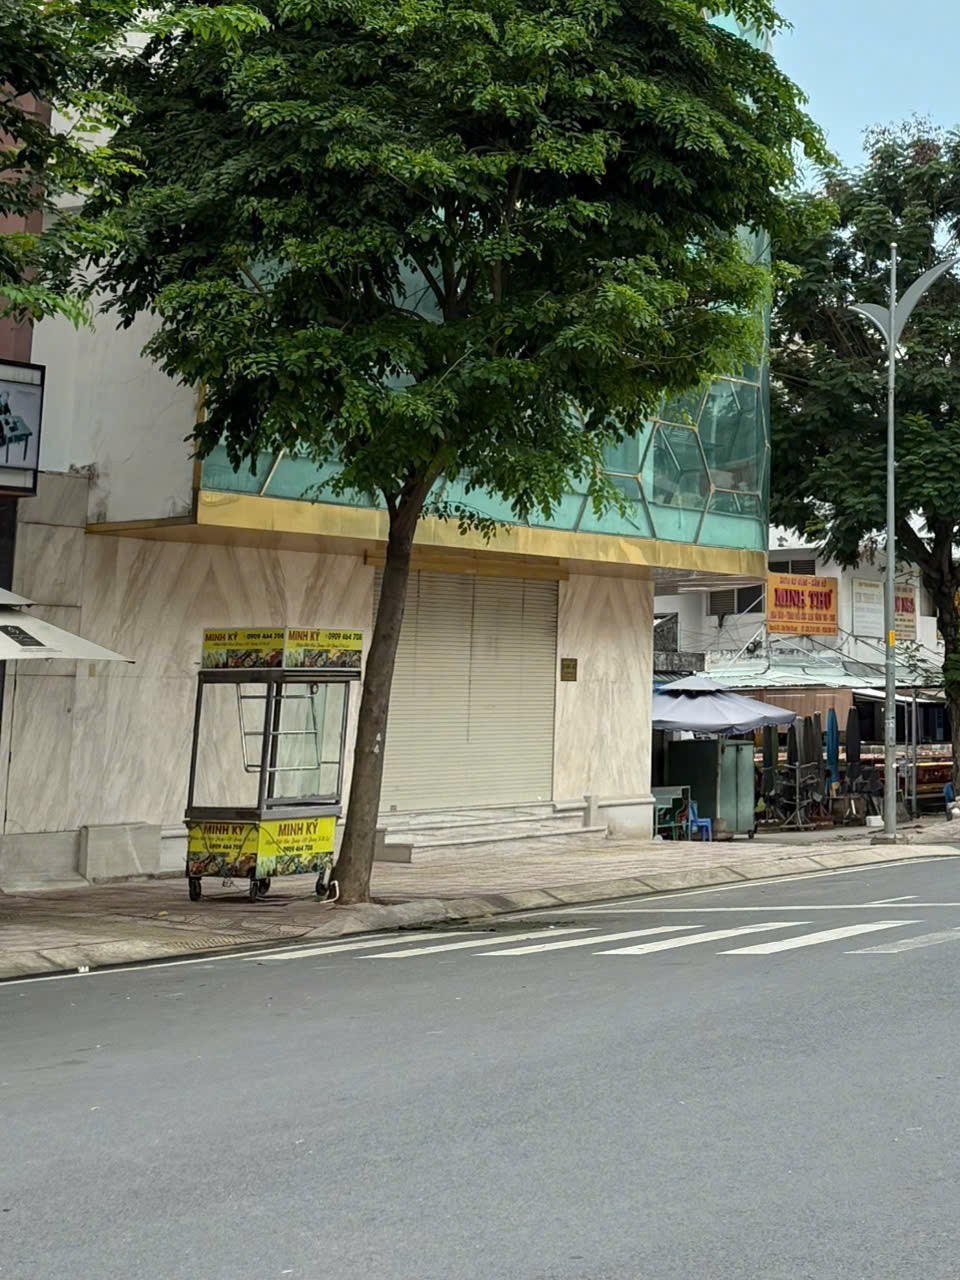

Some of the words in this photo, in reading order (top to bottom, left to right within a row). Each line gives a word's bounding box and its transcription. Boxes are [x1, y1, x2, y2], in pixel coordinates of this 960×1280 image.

[774, 588, 806, 609] MINH
[205, 633, 226, 641] MINH
[287, 630, 308, 641] MINH
[327, 632, 341, 640] 0909
[203, 824, 229, 835] MINH
[278, 822, 304, 837] MINH
